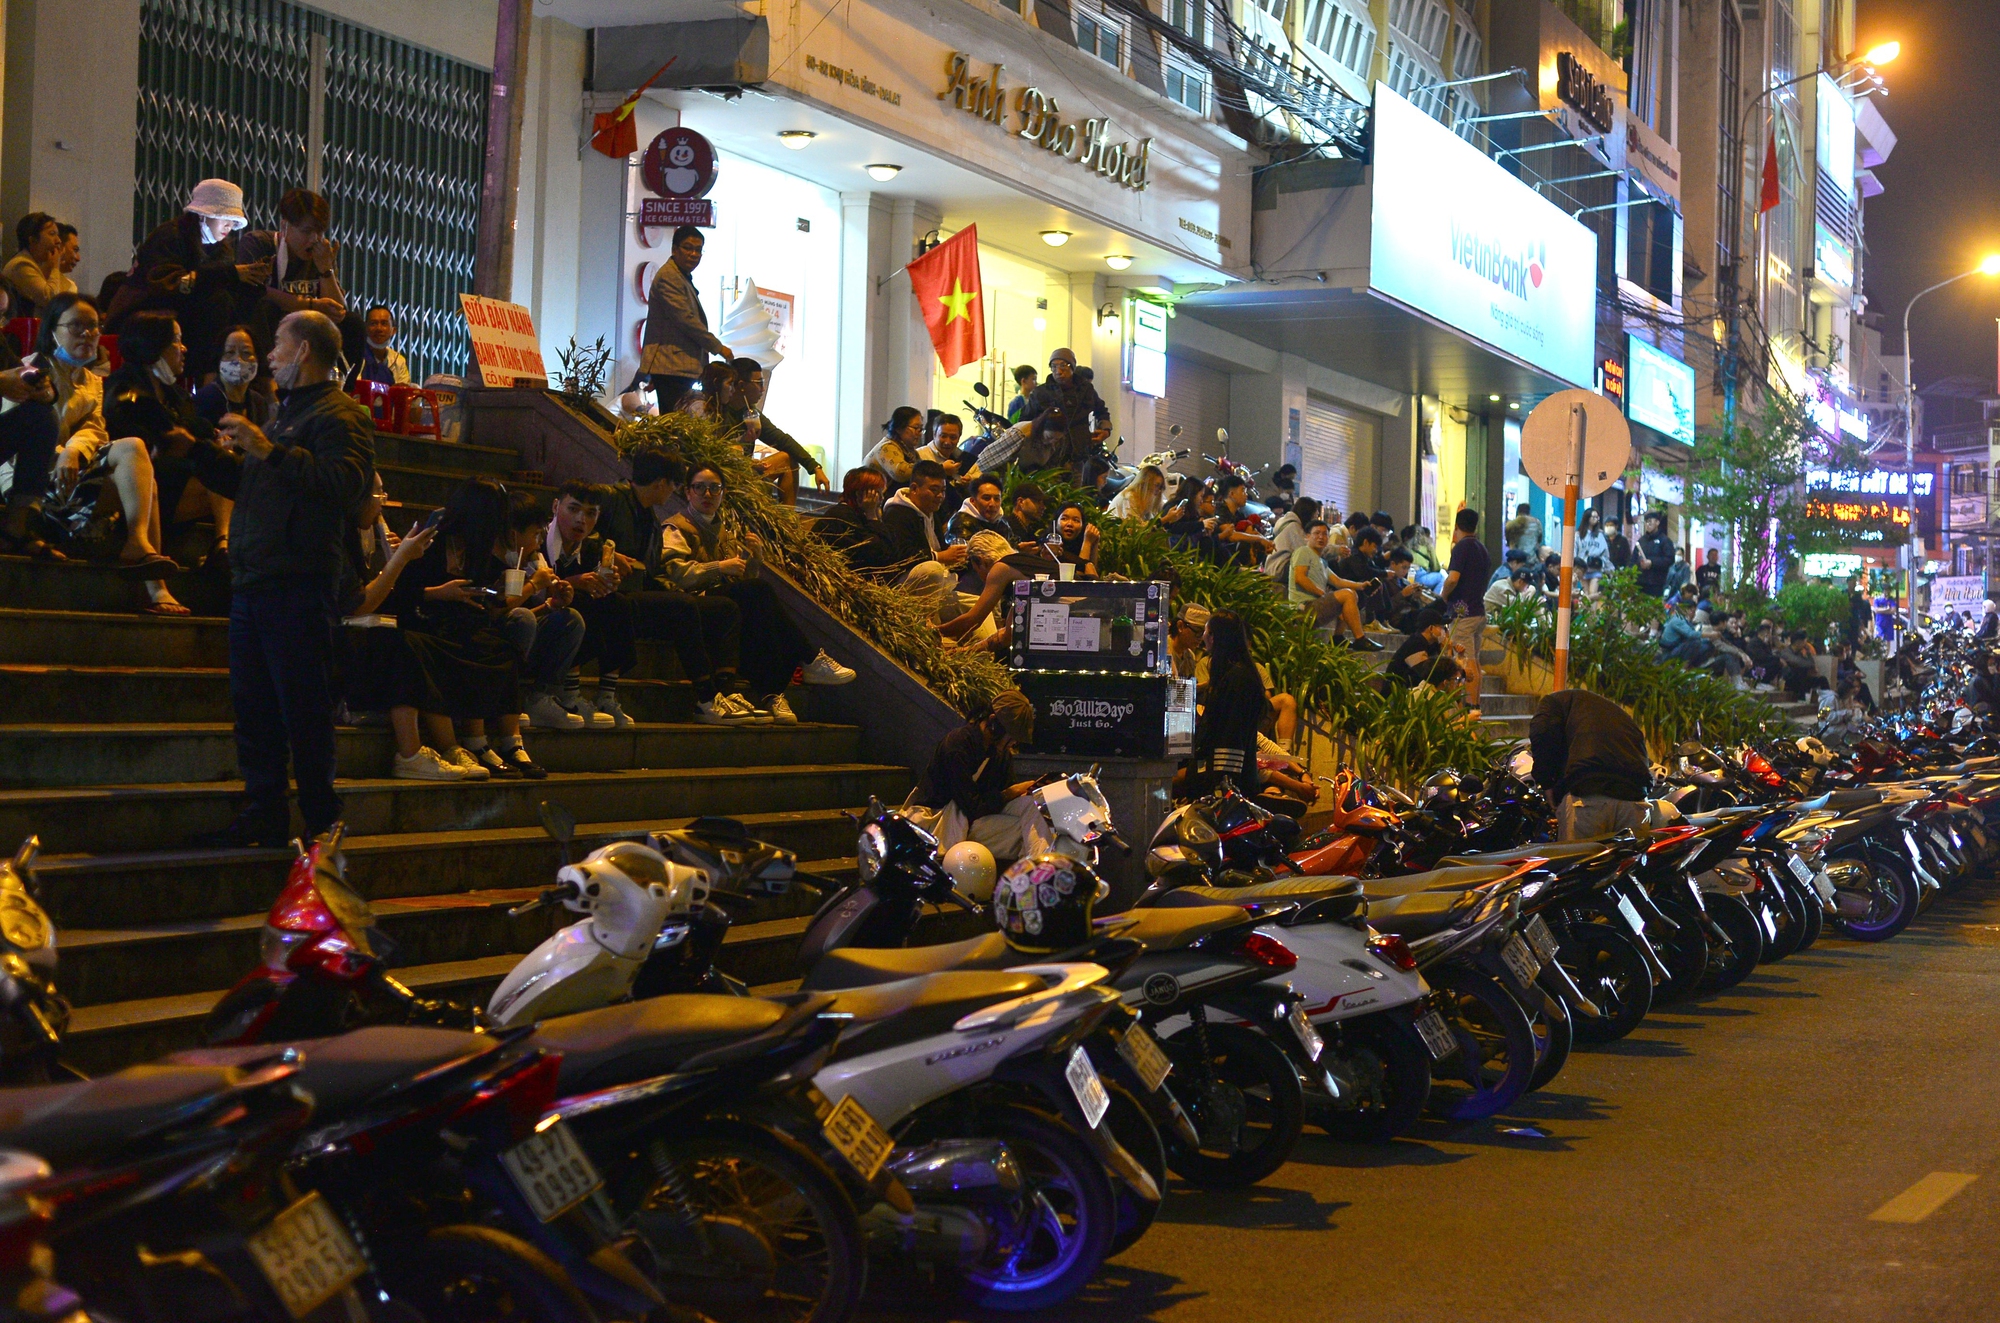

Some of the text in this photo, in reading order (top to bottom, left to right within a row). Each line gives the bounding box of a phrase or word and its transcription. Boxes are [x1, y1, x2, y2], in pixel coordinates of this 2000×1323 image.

[937, 51, 1007, 126] Anh
[1080, 117, 1155, 191] Hotel
[646, 202, 707, 214] SINCE 1997
[658, 215, 684, 223] CREAM
[1451, 214, 1528, 301] VietinBank
[464, 298, 488, 326] SỮA
[487, 301, 509, 335] ĐẬU
[474, 337, 498, 366] BÁNH
[496, 341, 524, 372] TRÁNG
[486, 370, 515, 387] CÔ NG
[436, 394, 454, 403] UN
[1069, 718, 1092, 728] Just
